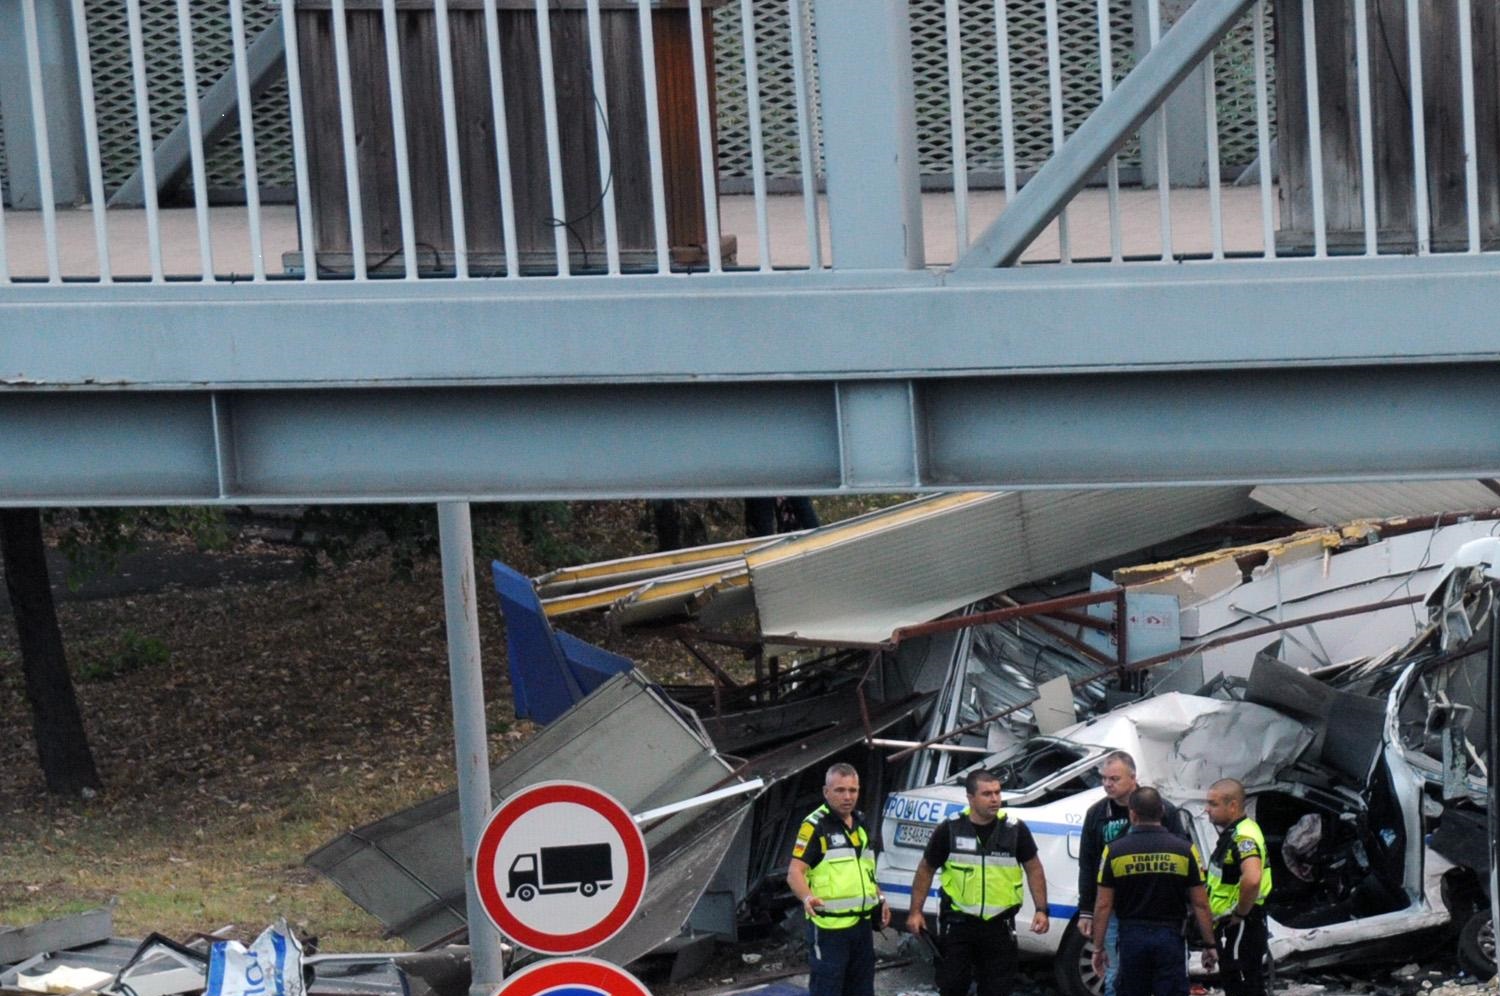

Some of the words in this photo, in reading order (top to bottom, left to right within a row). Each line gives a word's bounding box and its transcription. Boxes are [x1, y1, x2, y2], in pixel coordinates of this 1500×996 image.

[885, 796, 942, 822] POLICE
[1131, 853, 1172, 863] TRAFFIC
[1124, 861, 1178, 874] POLICE
